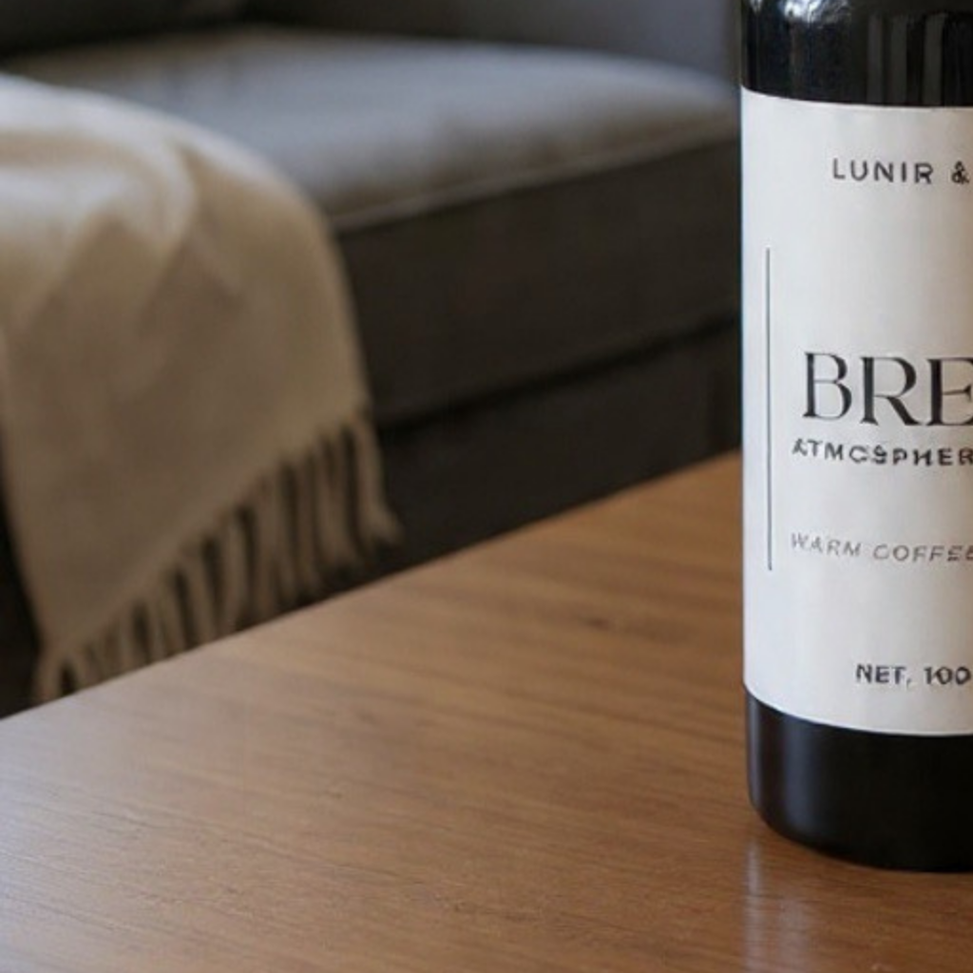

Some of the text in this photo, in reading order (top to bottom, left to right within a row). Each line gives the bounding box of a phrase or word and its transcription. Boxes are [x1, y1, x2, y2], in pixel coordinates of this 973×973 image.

[832, 157, 934, 185] LUNIR
[950, 160, 971, 186] &
[791, 533, 861, 557] WARM
